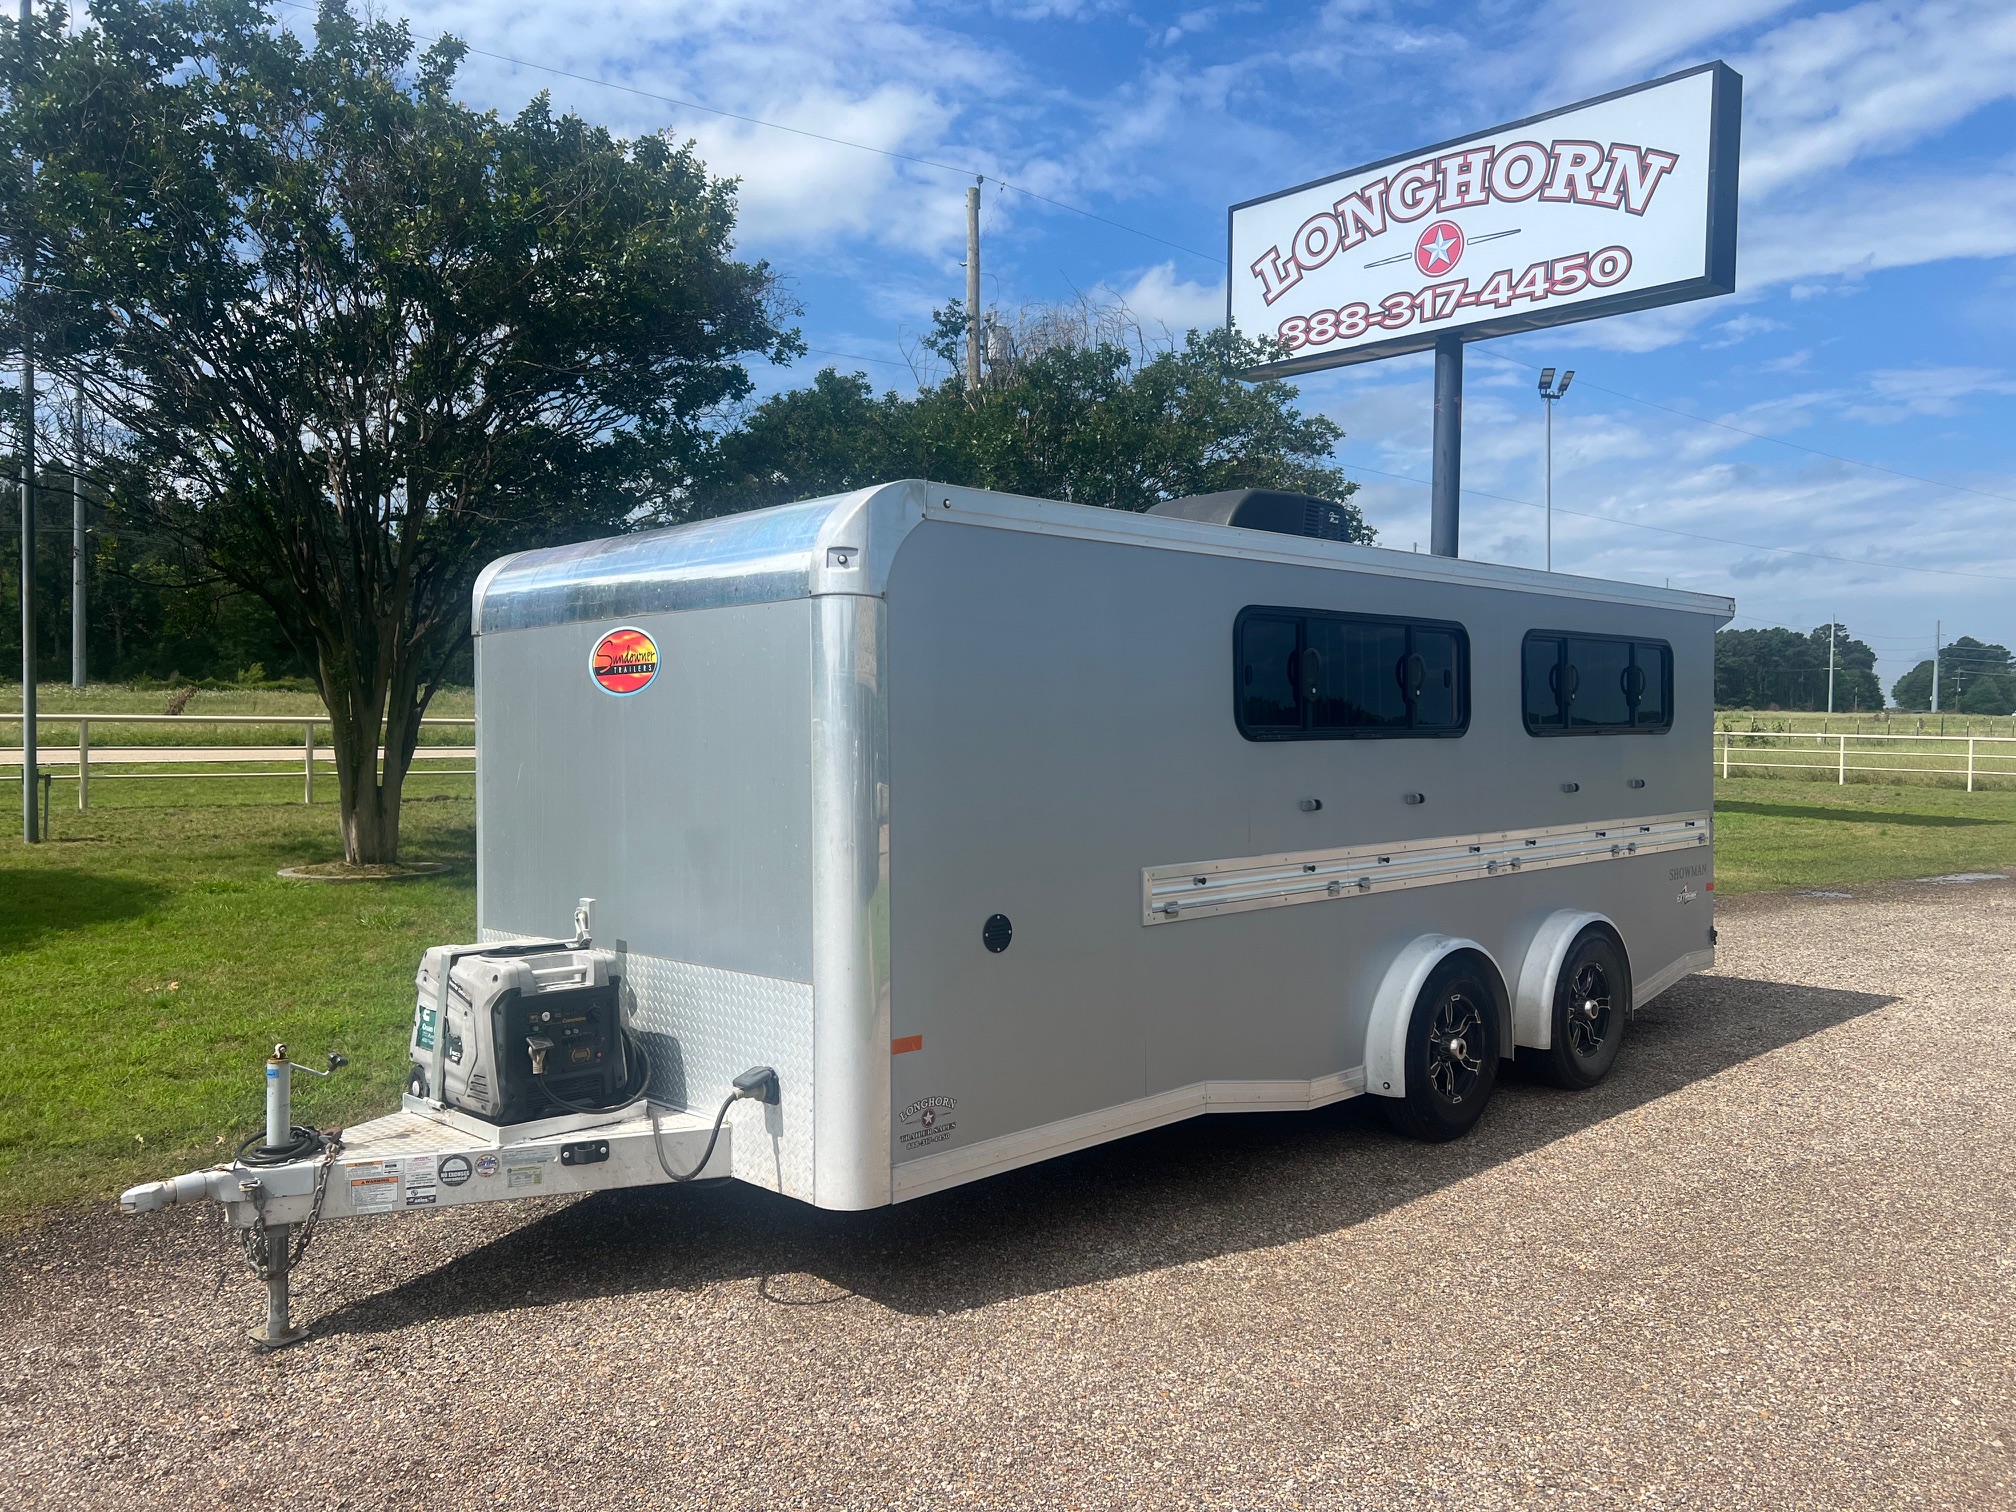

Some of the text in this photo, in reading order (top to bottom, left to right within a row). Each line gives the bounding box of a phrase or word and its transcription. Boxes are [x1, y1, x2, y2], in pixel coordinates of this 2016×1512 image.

[1251, 139, 1680, 305] LONGHORN
[1278, 245, 1633, 351] 888-317-4450
[597, 640, 656, 674] Sundowner
[613, 664, 653, 674] TRAILERS
[1669, 864, 1707, 881] SHOWMAN
[899, 1096, 957, 1122] LONGHORN
